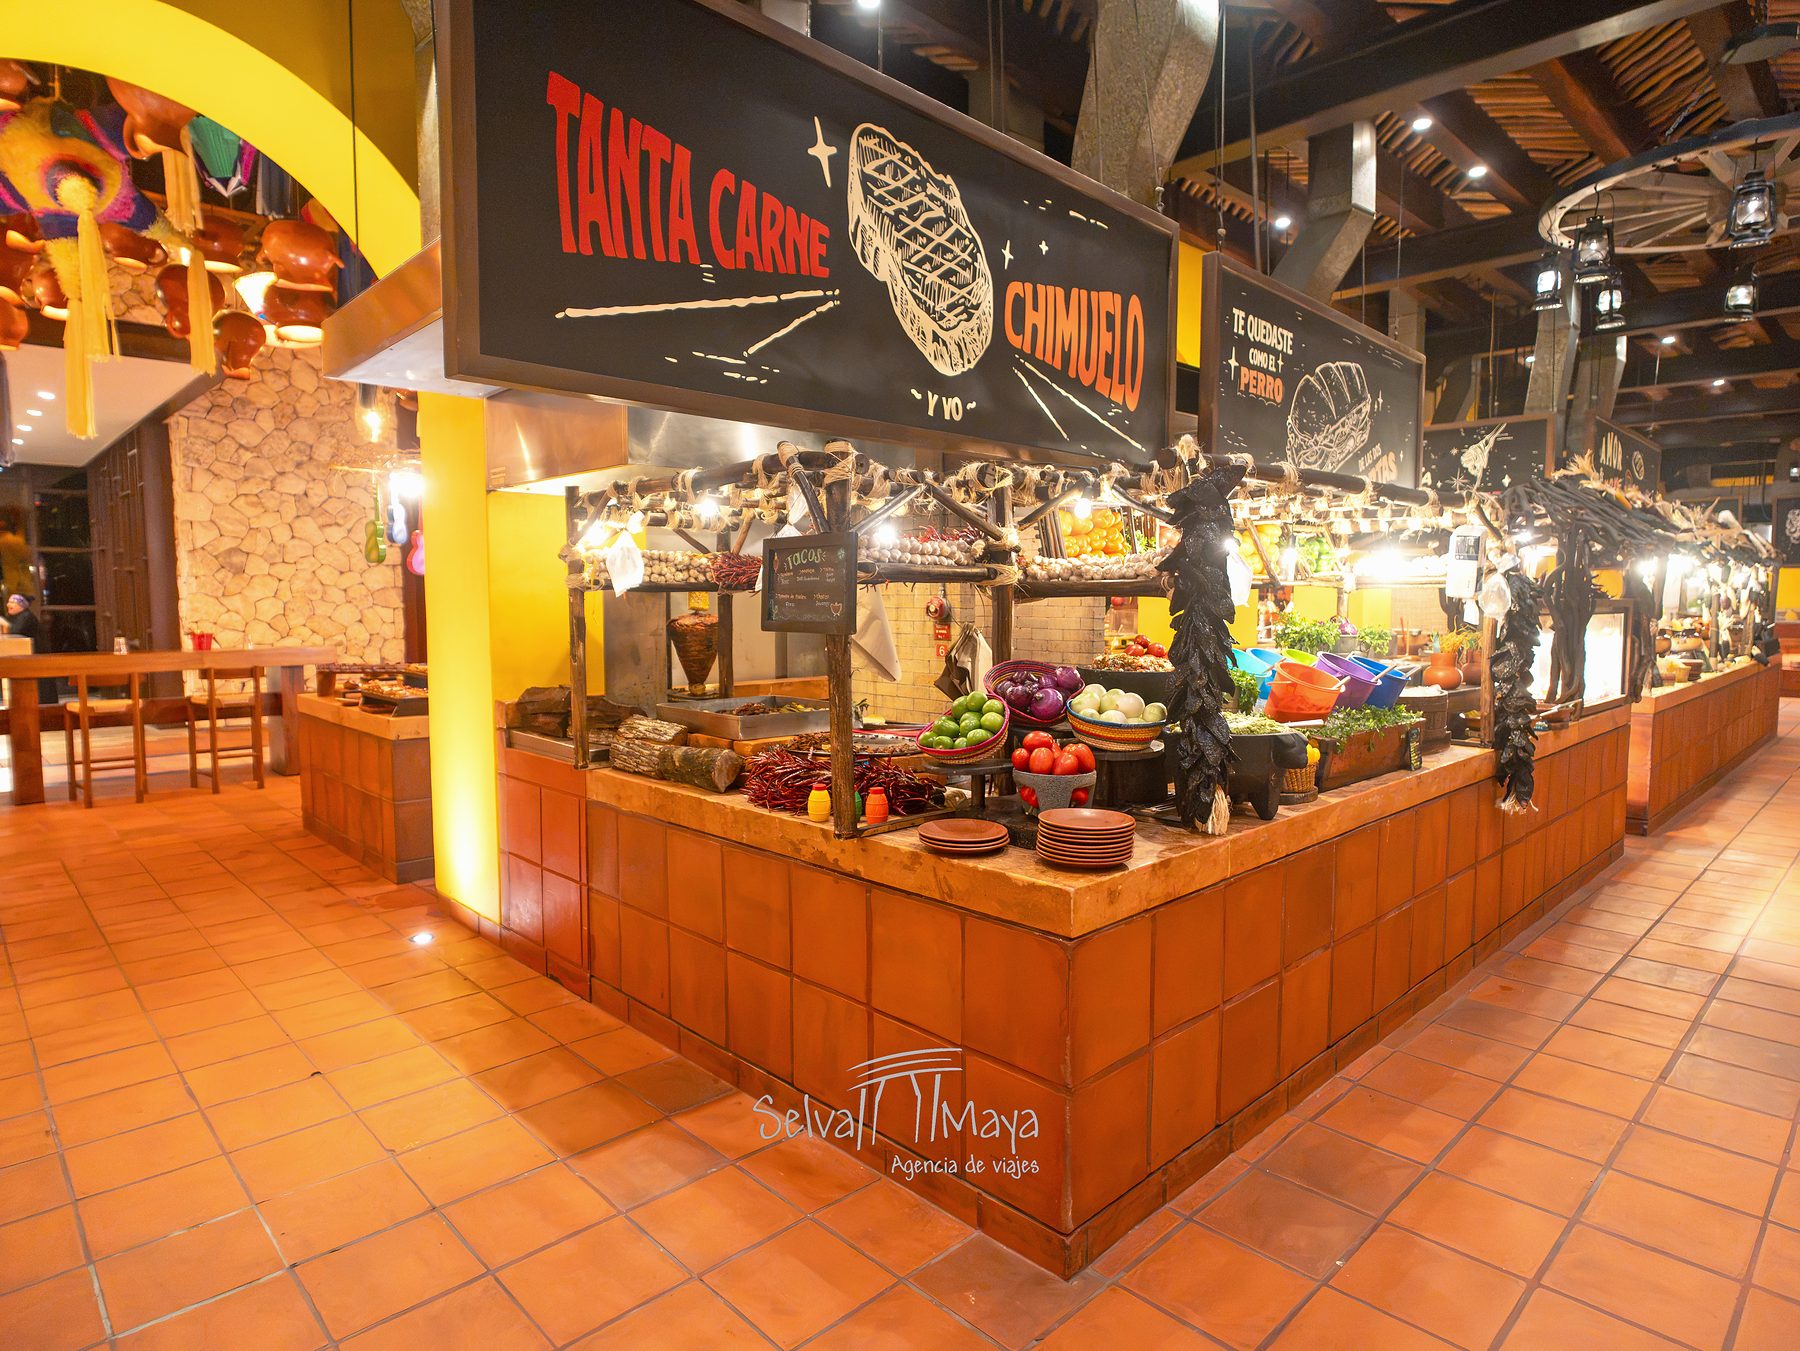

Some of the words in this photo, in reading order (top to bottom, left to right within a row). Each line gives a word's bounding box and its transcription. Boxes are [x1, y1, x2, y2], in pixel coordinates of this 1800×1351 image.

[546, 71, 700, 265] TANTA
[709, 169, 830, 278] CARNE
[1004, 281, 1146, 412] CHIMUELO
[1232, 307, 1246, 336] TE
[1247, 314, 1294, 355] QUEDASTE
[1248, 347, 1268, 369] COMO
[1268, 354, 1277, 373] EL
[1240, 366, 1284, 403] PERRO
[927, 390, 939, 417] Y
[941, 396, 963, 421] YO
[1599, 431, 1623, 472] AMOR
[939, 645, 945, 657] 6
